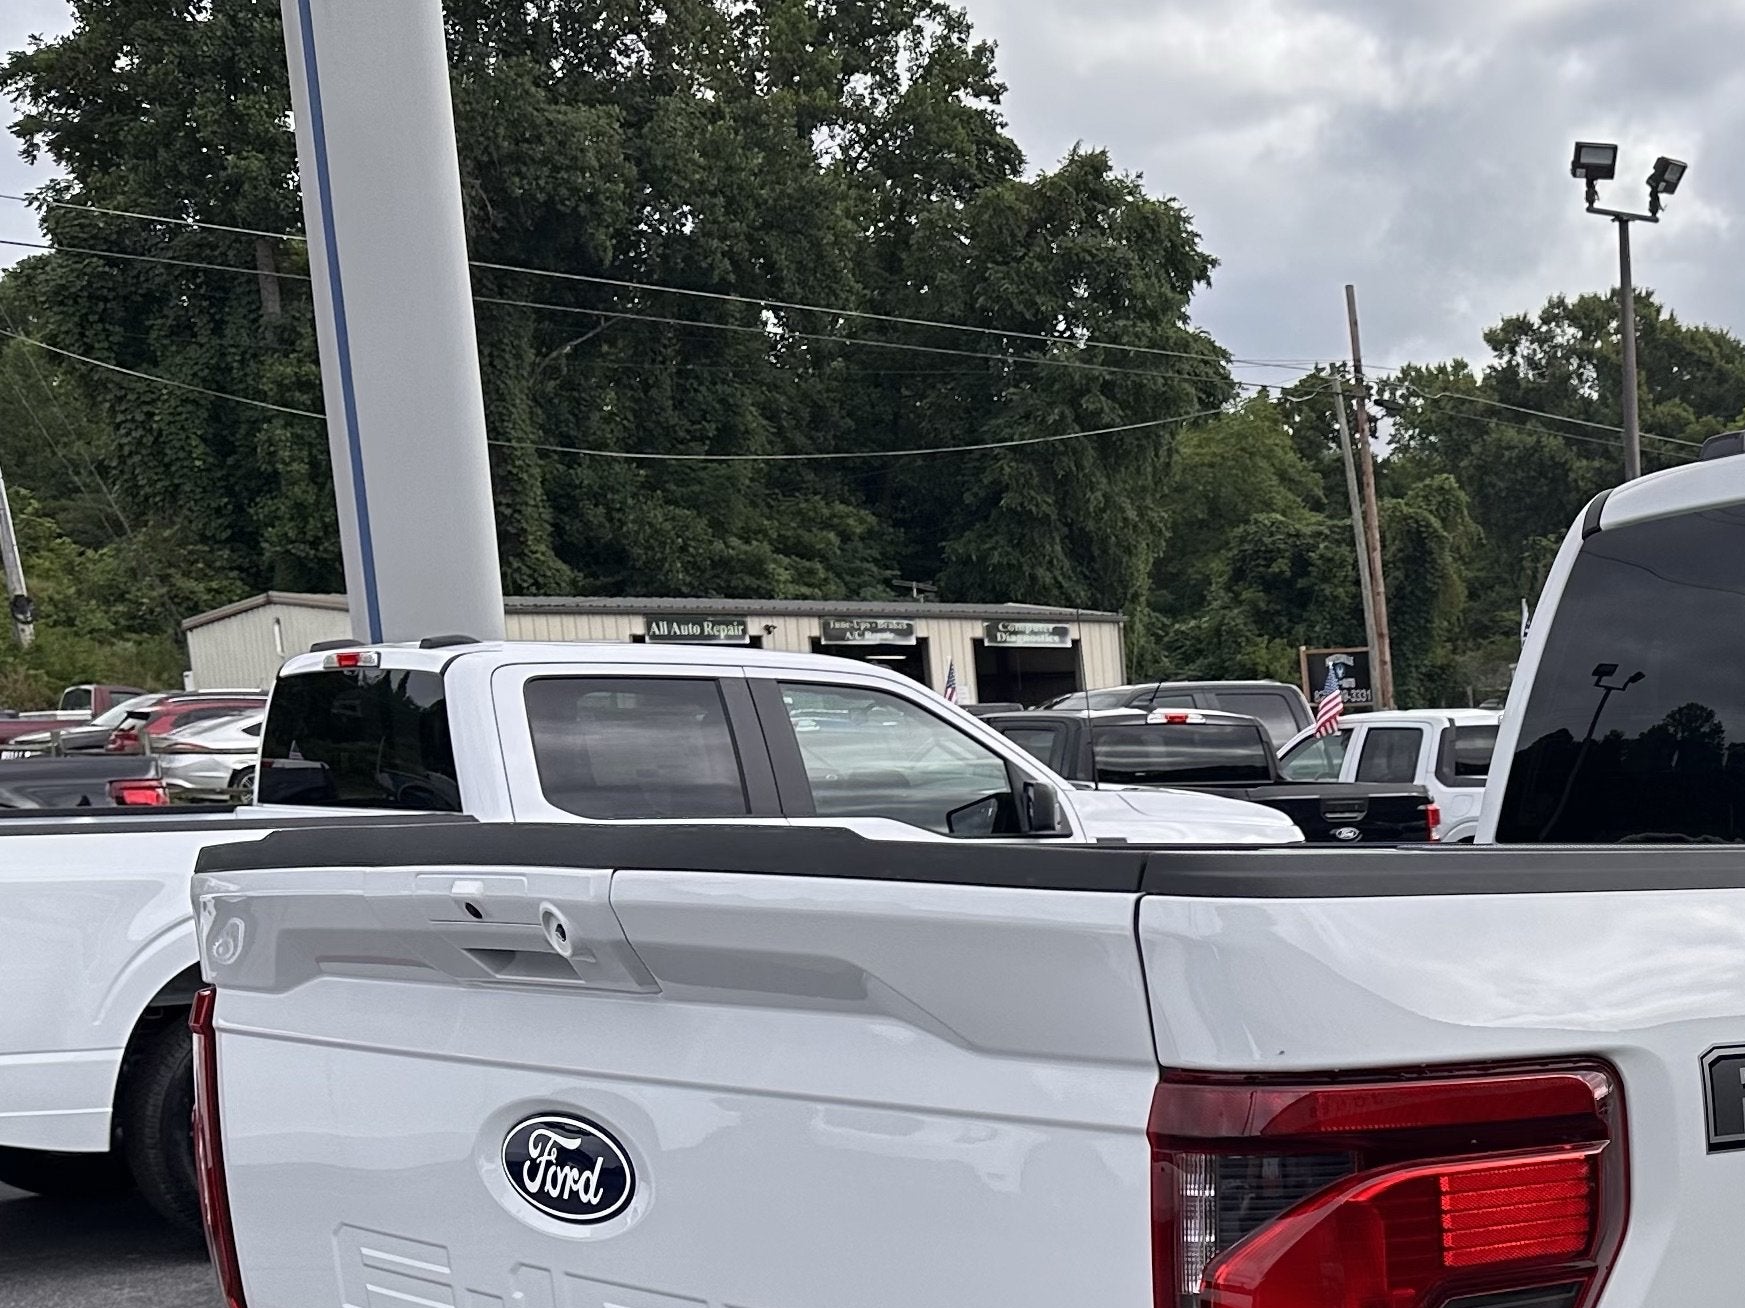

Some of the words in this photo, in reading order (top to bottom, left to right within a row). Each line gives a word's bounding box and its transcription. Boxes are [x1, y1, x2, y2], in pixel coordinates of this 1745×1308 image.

[649, 621, 668, 636] All
[670, 622, 701, 636] Auto
[703, 621, 745, 639] Repair
[522, 1128, 604, 1206] Ford
